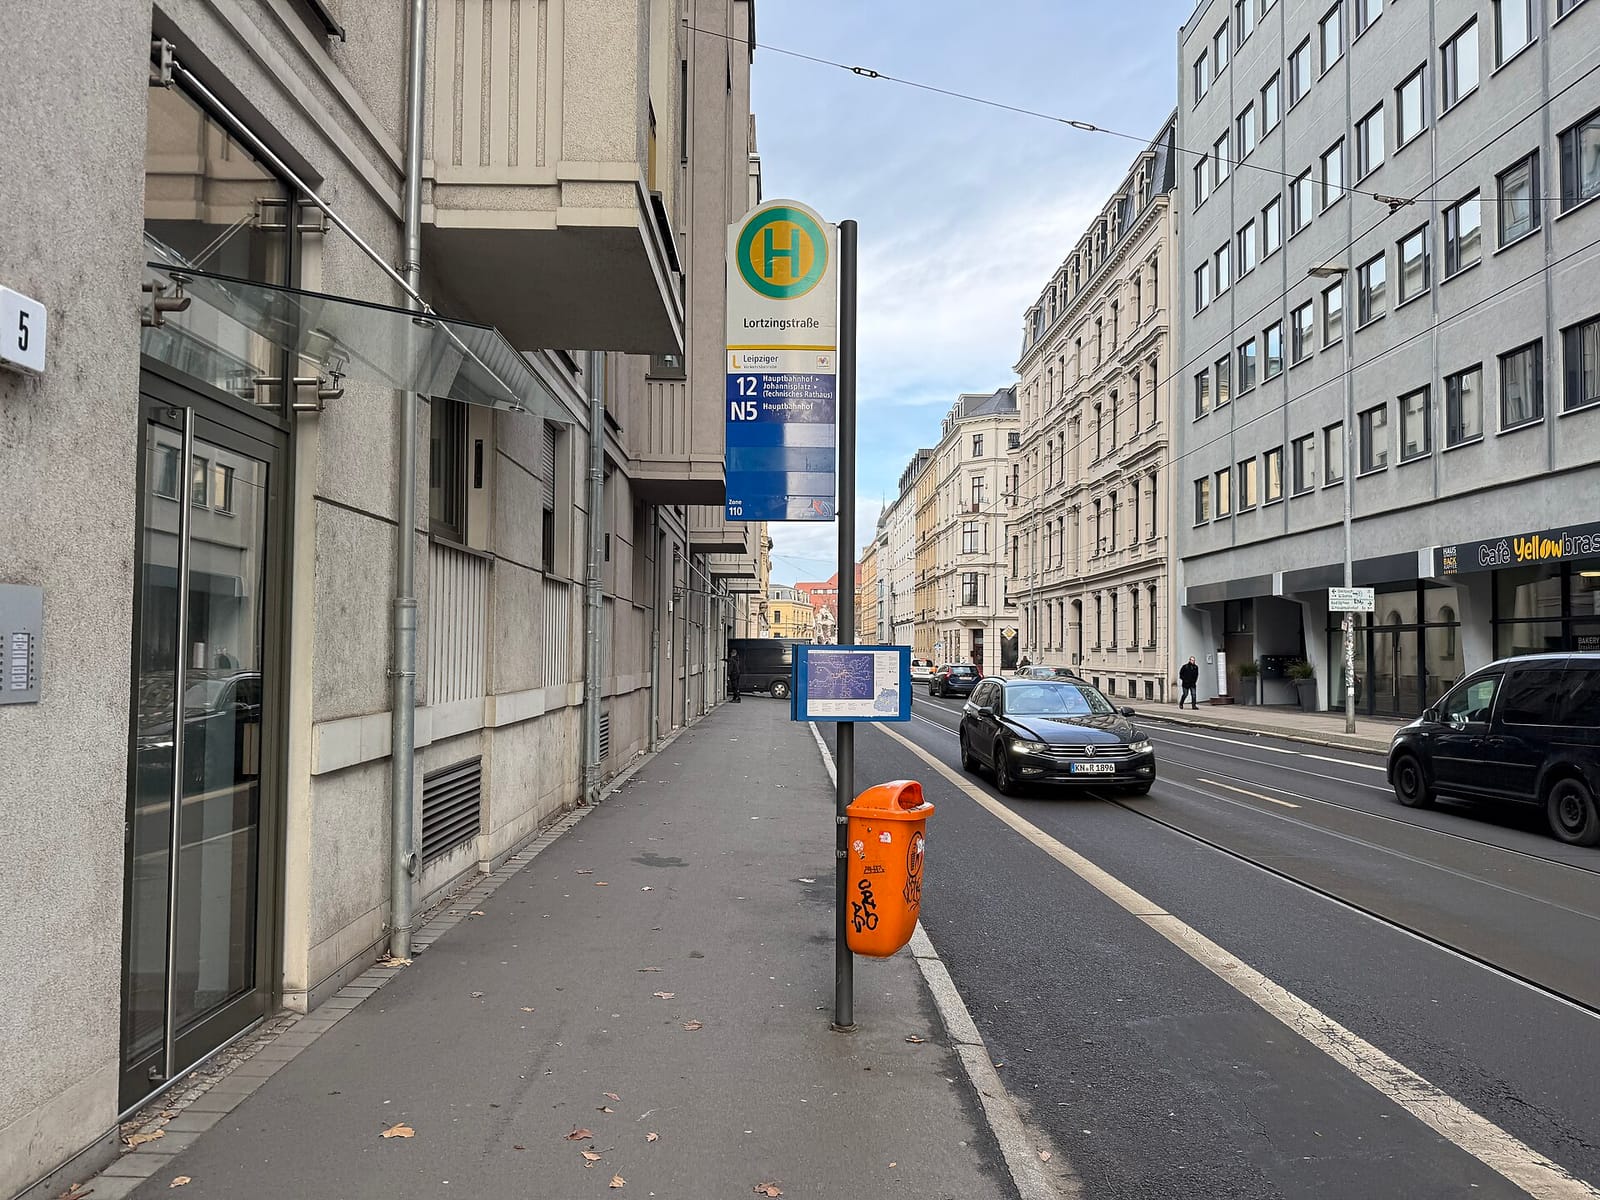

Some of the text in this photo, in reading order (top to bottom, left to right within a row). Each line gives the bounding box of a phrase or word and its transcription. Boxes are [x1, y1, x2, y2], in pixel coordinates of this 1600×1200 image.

[764, 228, 799, 278] H
[743, 317, 820, 331] Lortzingstraße
[18, 310, 29, 351] 5
[743, 354, 779, 364] Leipziger
[763, 375, 813, 383] Hauptbahnhof
[736, 376, 757, 396] 12
[762, 390, 833, 399] (Technisches Rathaus)
[731, 401, 758, 421] N5
[763, 403, 814, 411] Hauptbahnhof
[729, 507, 742, 516] 110
